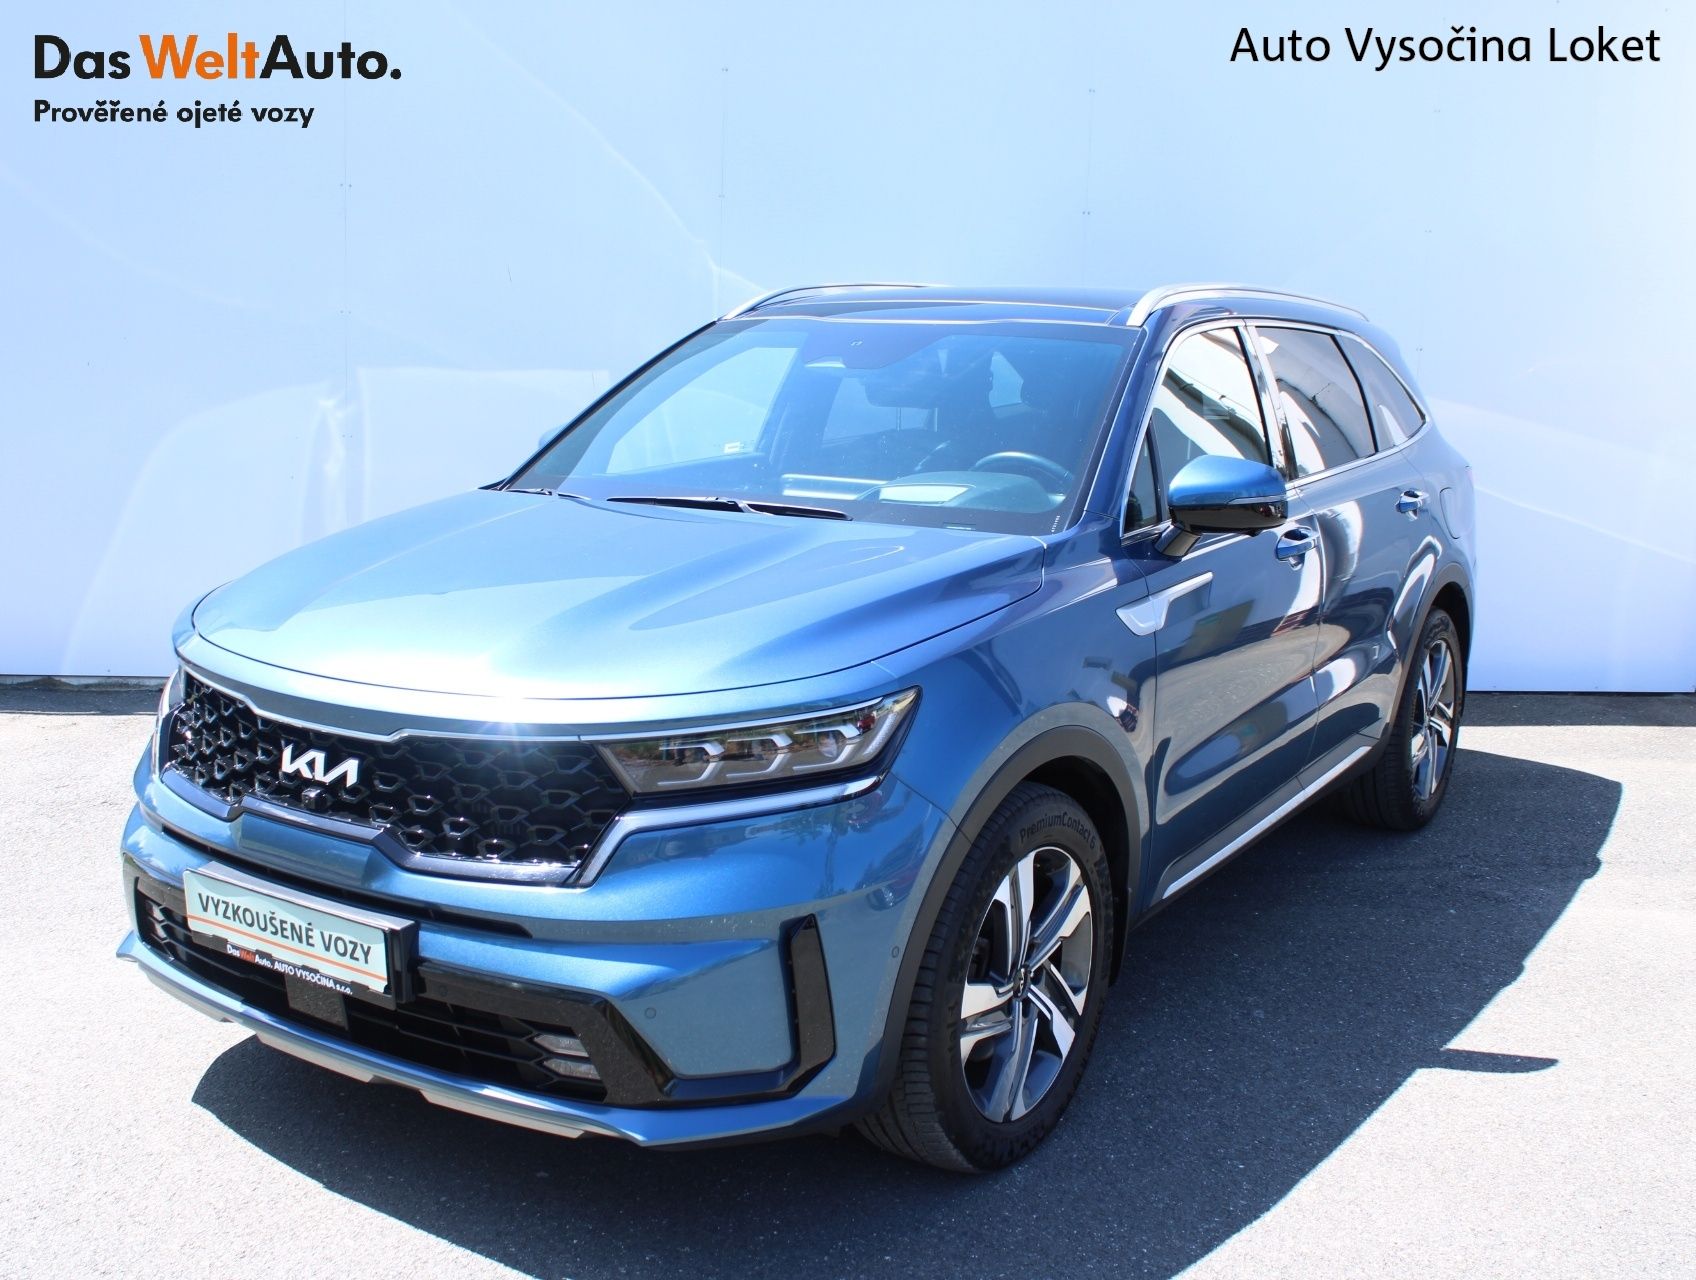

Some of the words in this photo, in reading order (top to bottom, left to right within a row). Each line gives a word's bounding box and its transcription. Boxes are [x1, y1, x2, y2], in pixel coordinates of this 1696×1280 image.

[1020, 811, 1091, 842] PremiumContact
[198, 892, 315, 947] VYZKOUŠENÉ
[320, 931, 372, 964] VOZY
[274, 961, 294, 975] AUTO
[295, 968, 336, 989] VYSOČINA
[336, 984, 353, 995] s.r.o.
